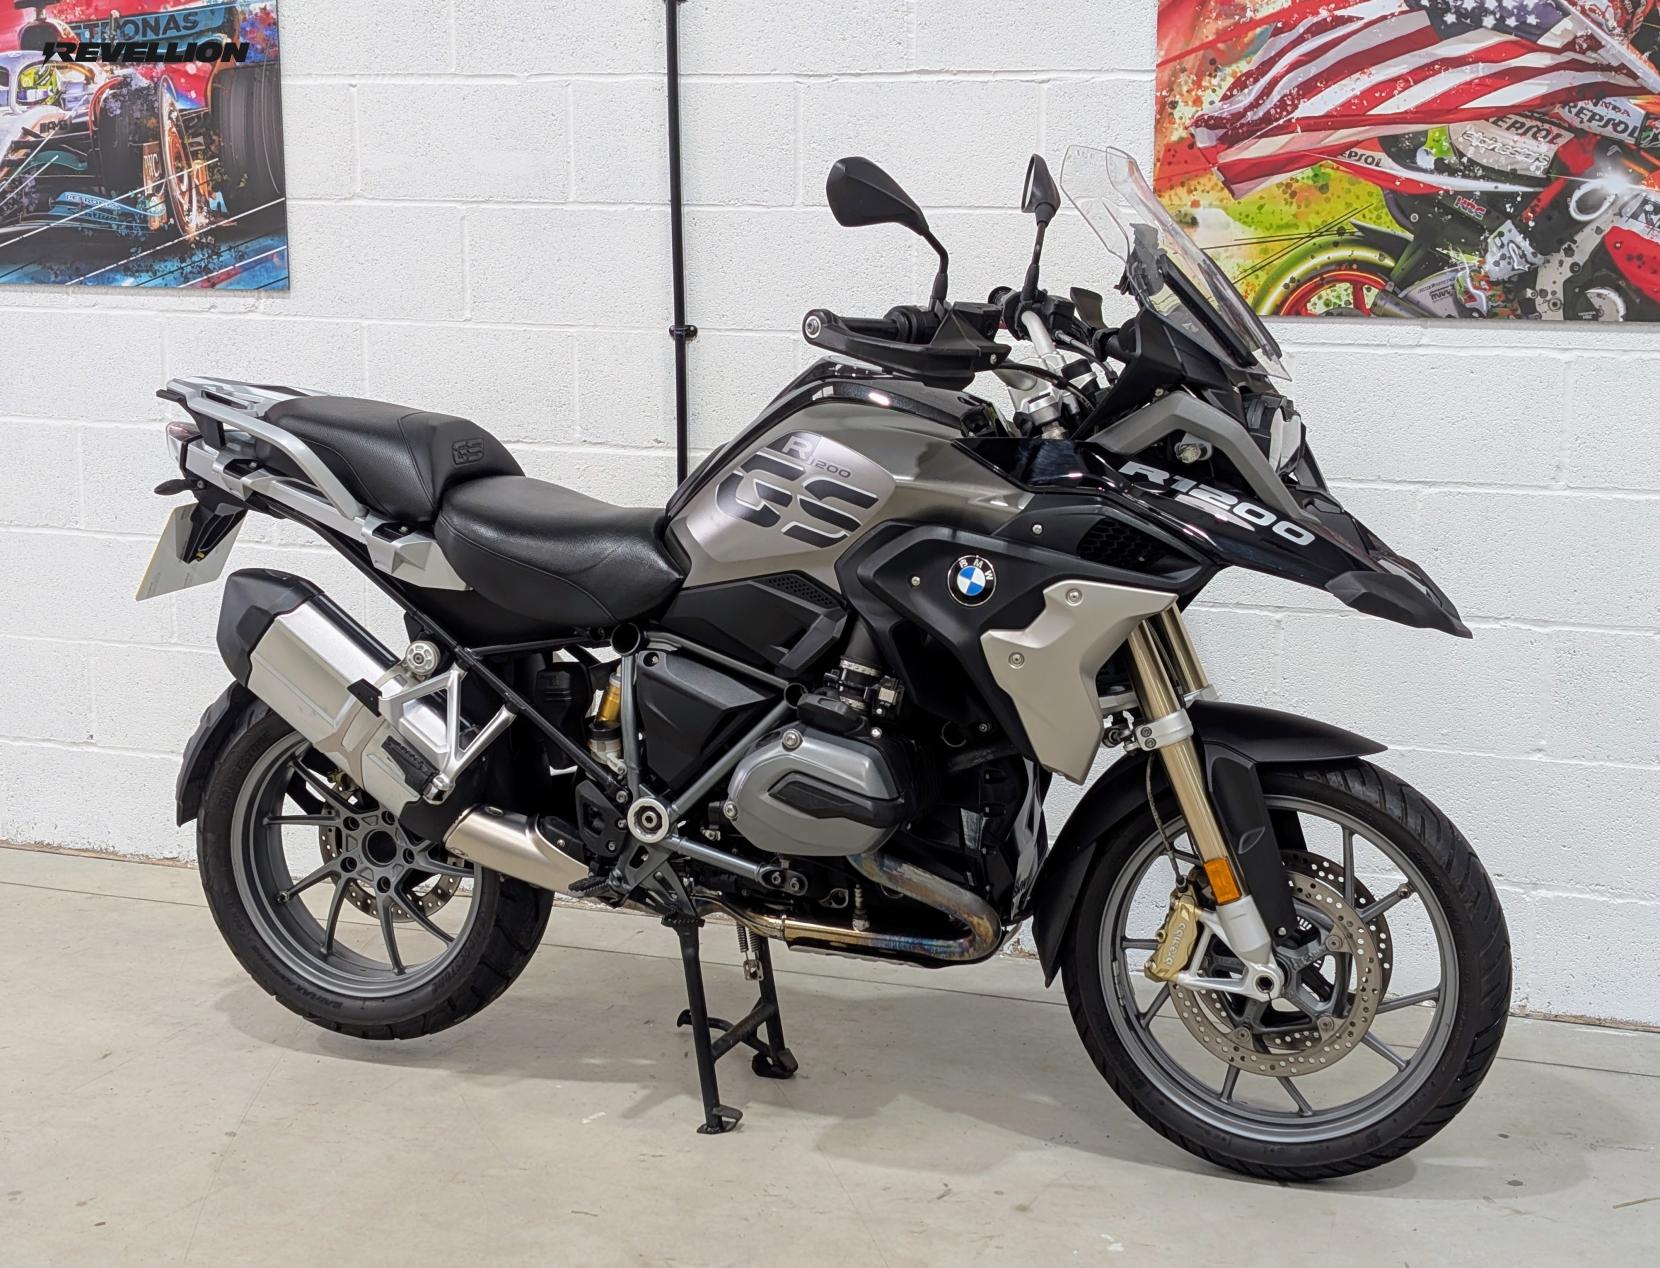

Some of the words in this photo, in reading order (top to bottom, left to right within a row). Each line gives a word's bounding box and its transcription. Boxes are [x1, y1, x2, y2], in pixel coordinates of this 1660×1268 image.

[1489, 114, 1564, 145] EPSOL
[452, 439, 484, 465] GS
[715, 450, 879, 549] GS
[1118, 460, 1316, 546] R1200
[958, 558, 994, 581] BMW
[1164, 922, 1186, 967] brembo
